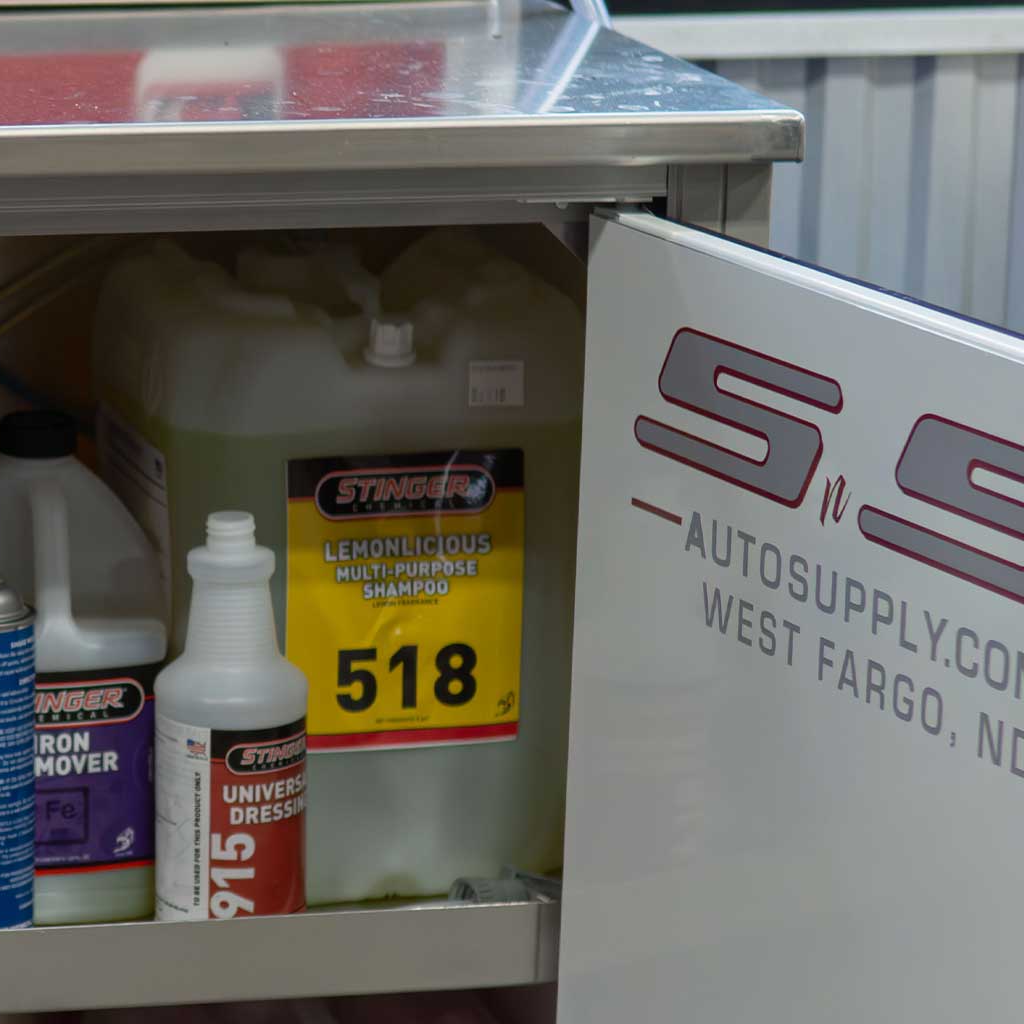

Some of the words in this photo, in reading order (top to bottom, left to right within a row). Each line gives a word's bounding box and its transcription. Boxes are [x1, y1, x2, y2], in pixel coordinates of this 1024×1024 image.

[336, 474, 473, 505] STINGER
[324, 534, 492, 562] LEMONLICIOUS
[336, 559, 478, 583] MULTI-PURPOSE
[363, 580, 449, 600] SHAMPOO
[702, 581, 801, 667] WEST
[817, 636, 957, 748] FARGO,
[336, 642, 478, 714] 518
[35, 687, 125, 713] INGER
[39, 710, 109, 723] EMICAL
[35, 732, 90, 754] IRON
[35, 752, 118, 777] MOVER
[45, 799, 77, 821] Fe
[230, 798, 307, 826] DRESSIN
[210, 832, 256, 919] 915
